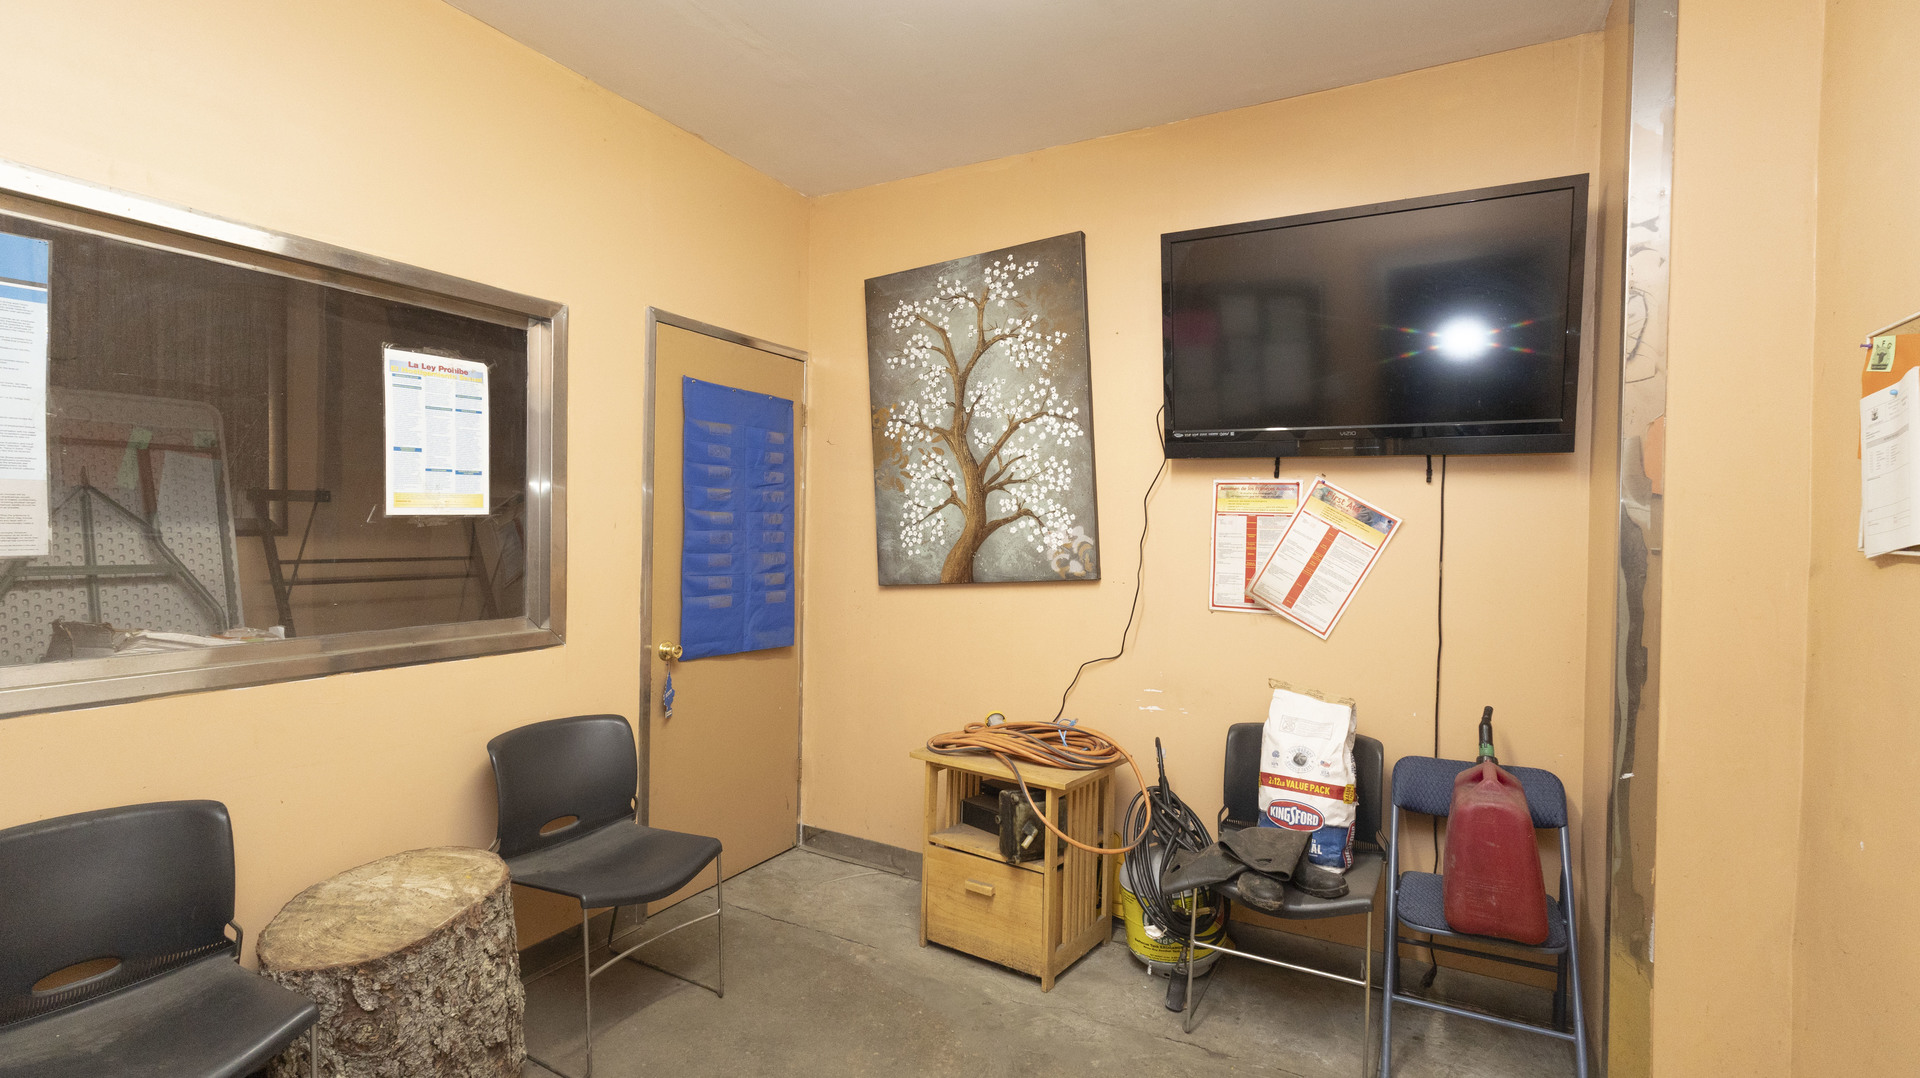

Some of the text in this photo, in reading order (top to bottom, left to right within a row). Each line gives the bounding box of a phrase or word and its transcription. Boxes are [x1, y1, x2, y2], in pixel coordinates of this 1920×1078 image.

[422, 362, 436, 372] Ley
[438, 365, 469, 376] Prohibe
[1326, 490, 1346, 505] First
[1346, 501, 1362, 512] Aid
[1286, 779, 1309, 792] VALUE
[1310, 784, 1331, 795] PACK
[1270, 806, 1320, 826] KINGSFORD
